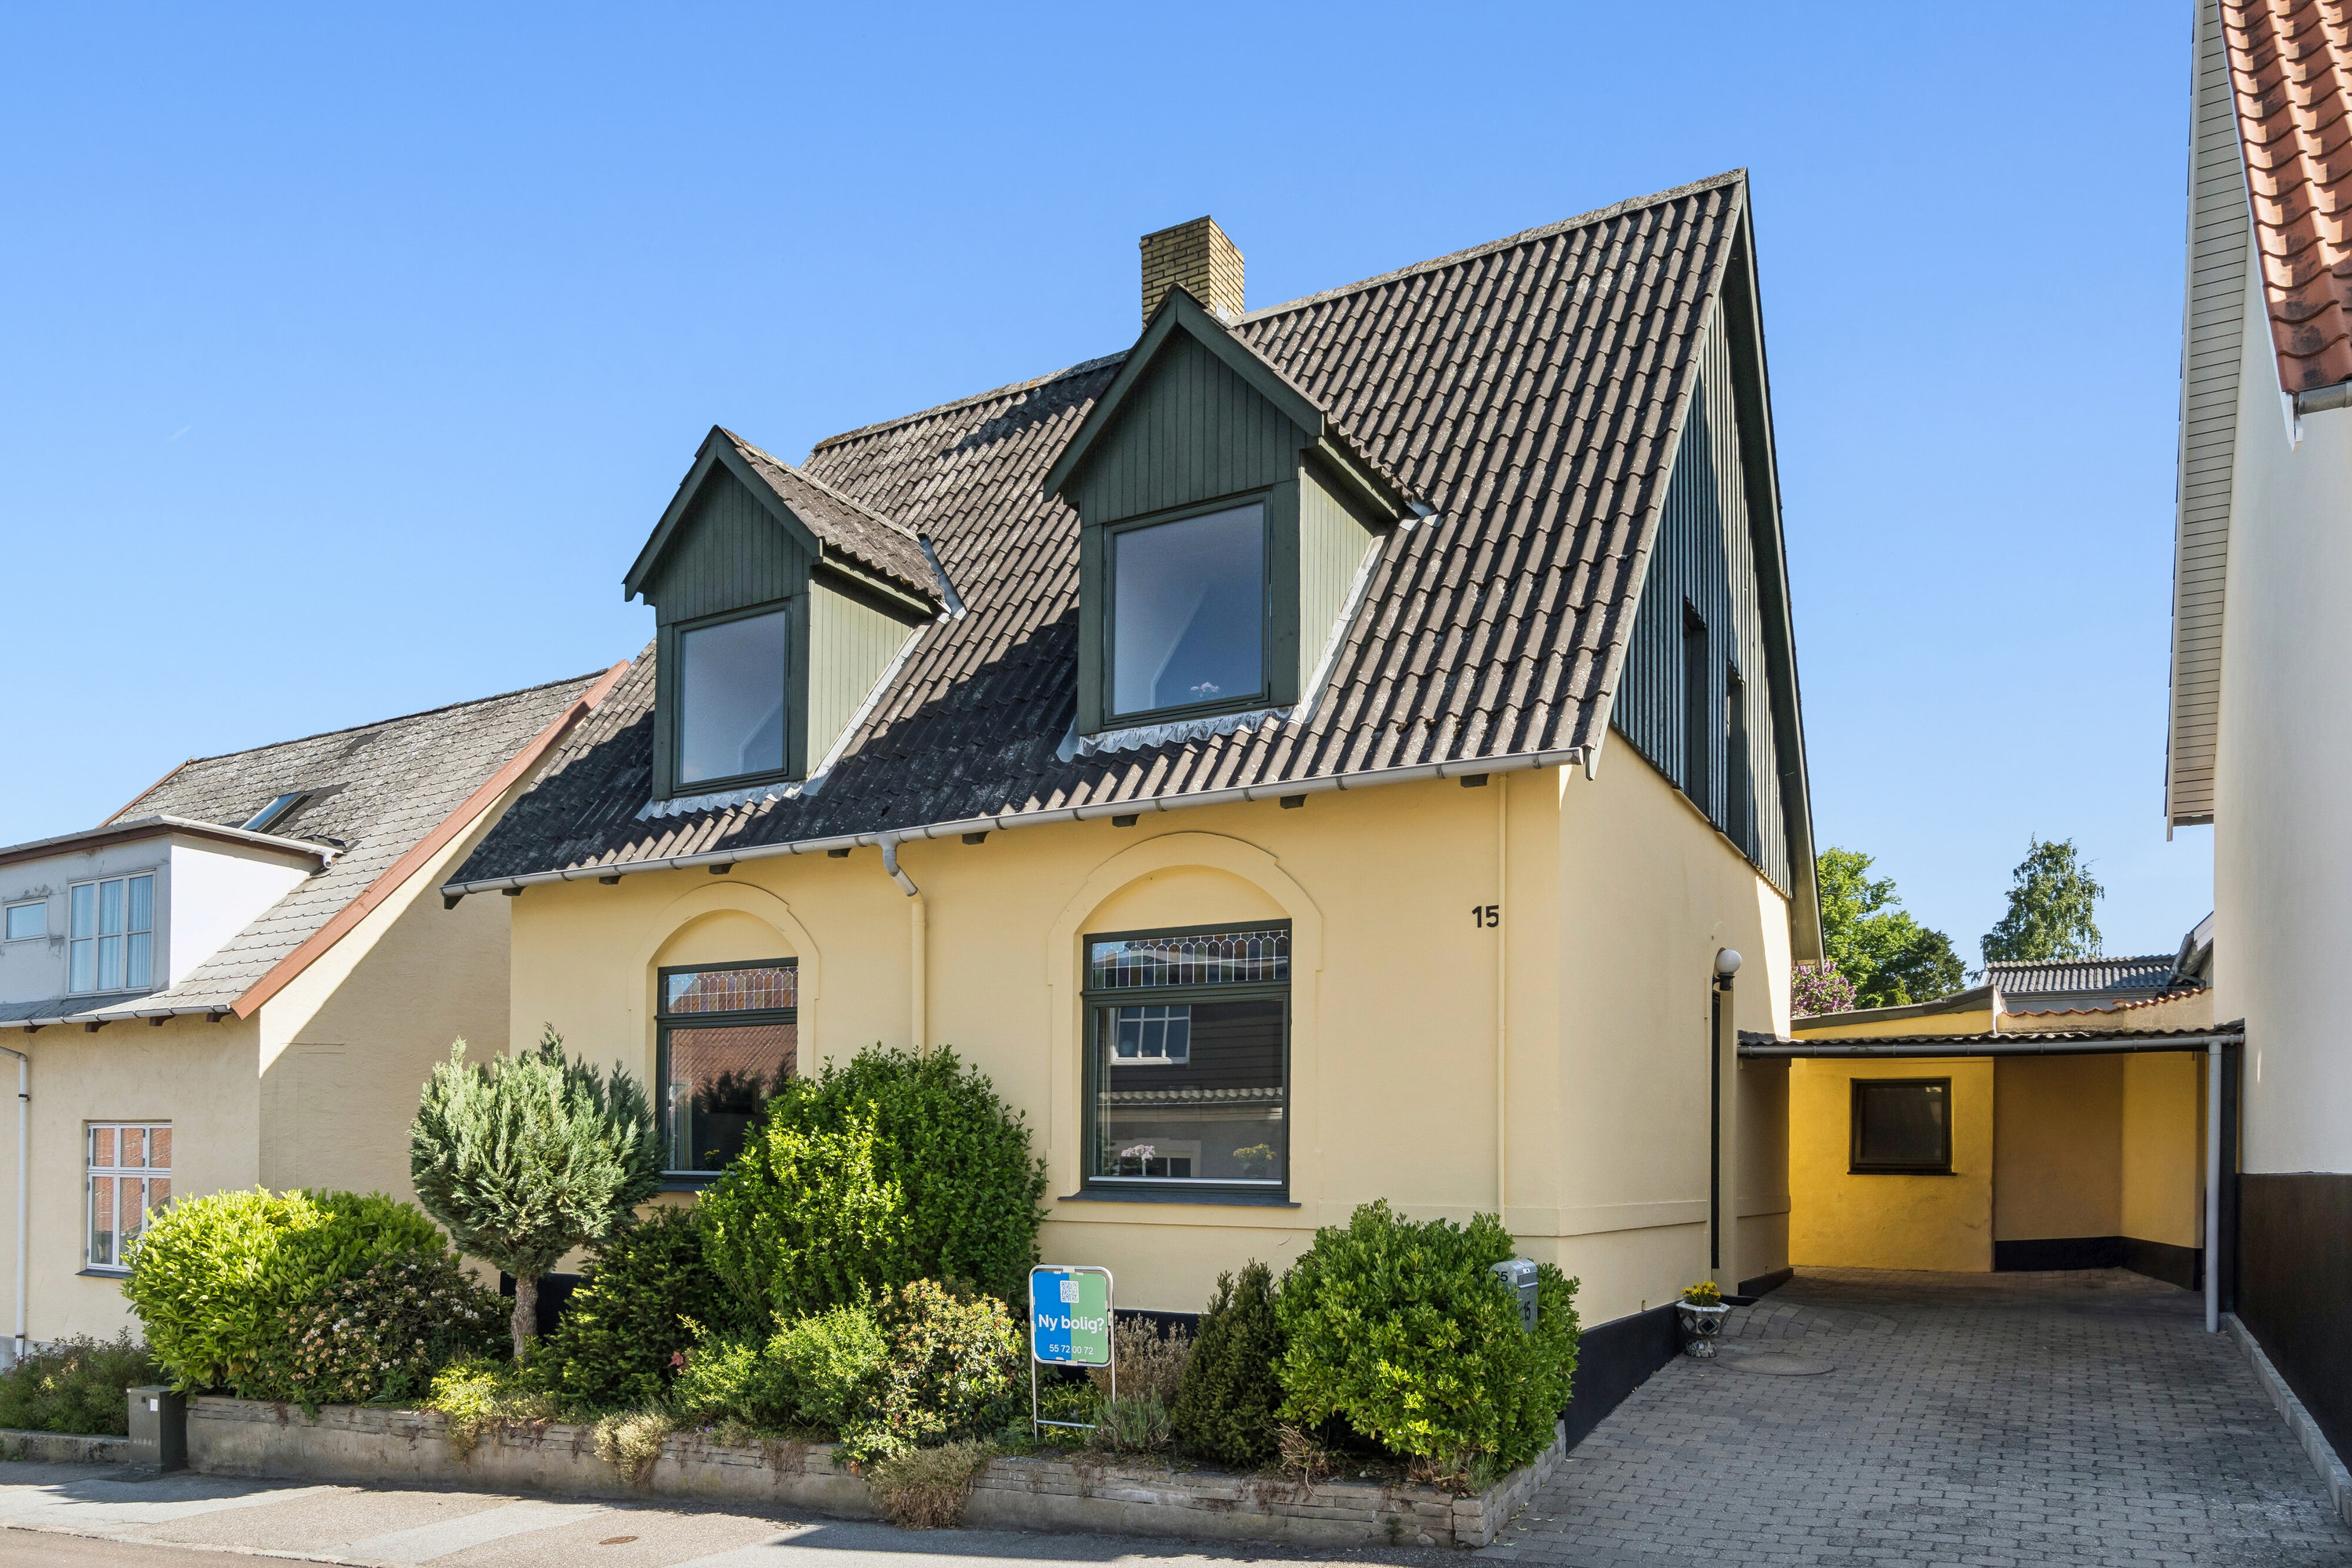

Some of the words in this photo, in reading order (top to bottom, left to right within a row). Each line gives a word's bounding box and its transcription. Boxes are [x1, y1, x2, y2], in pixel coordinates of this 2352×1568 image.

[1472, 905, 1499, 928] 15
[1523, 1301, 1530, 1321] 15
[1038, 1313, 1058, 1331] Ny
[1061, 1315, 1105, 1334] bolig?
[1049, 1344, 1059, 1352] 55
[1061, 1345, 1071, 1353] 72
[1072, 1345, 1082, 1354] 00
[1083, 1346, 1094, 1355] 72
